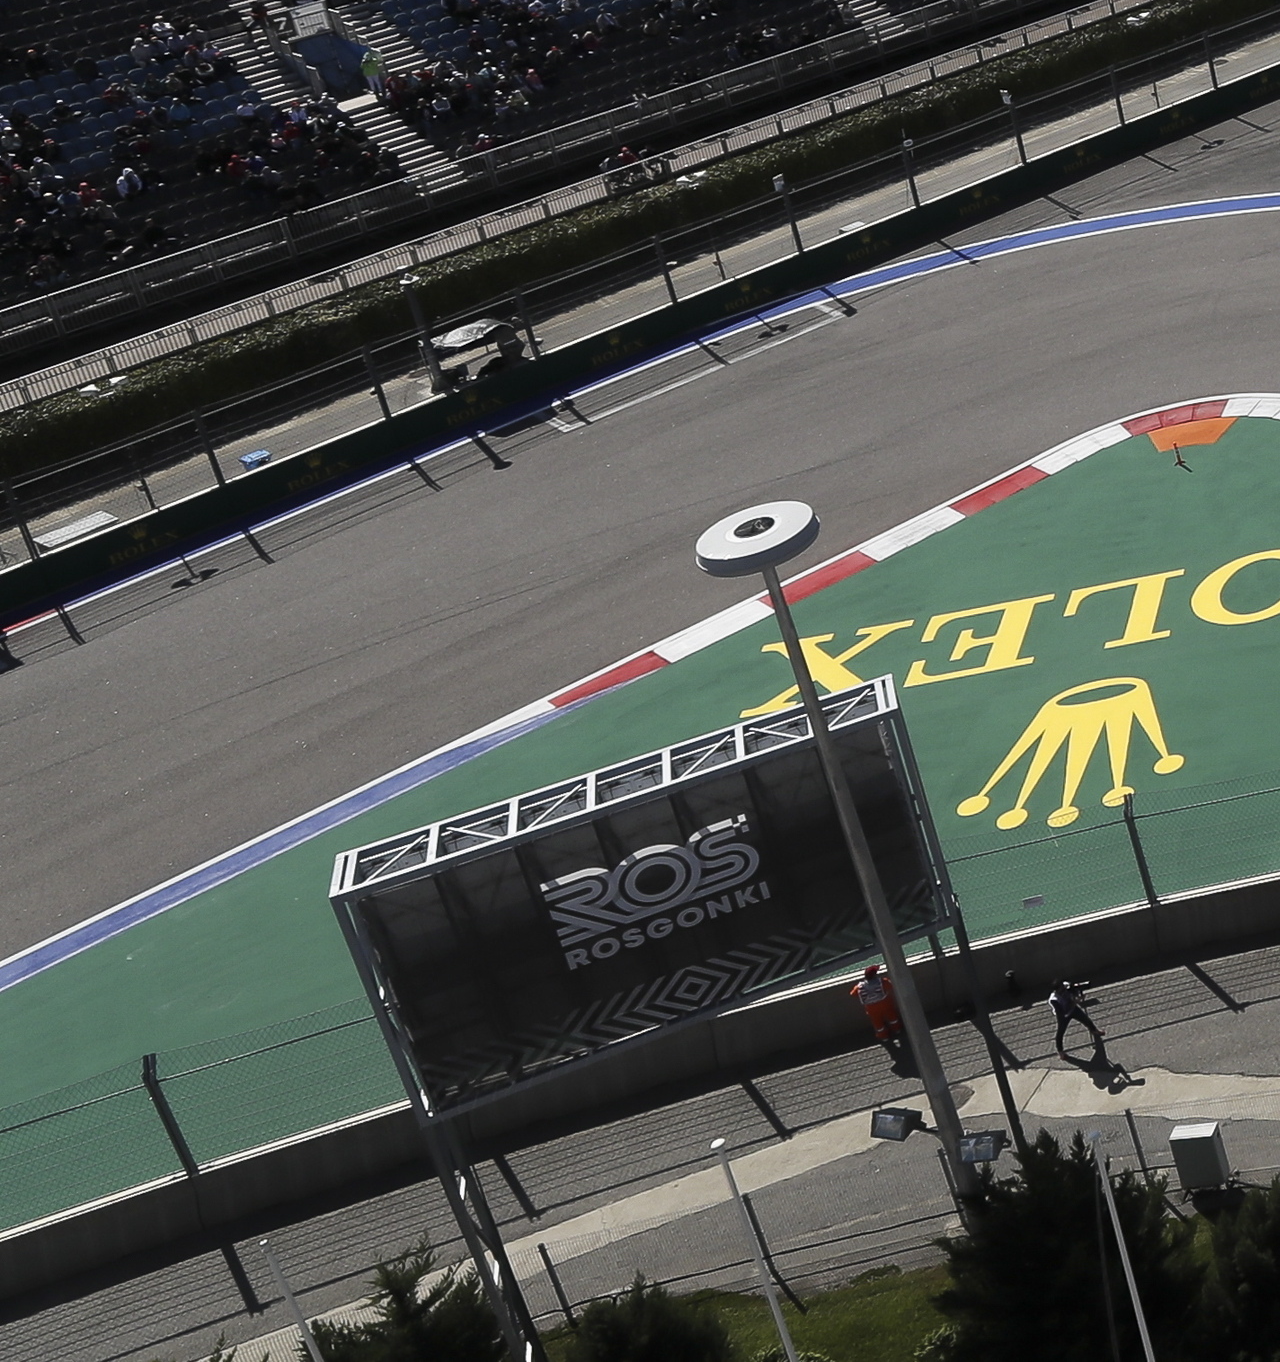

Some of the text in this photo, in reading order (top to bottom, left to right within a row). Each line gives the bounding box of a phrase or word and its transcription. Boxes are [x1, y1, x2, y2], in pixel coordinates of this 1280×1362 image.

[959, 195, 1001, 217] ROLEX
[846, 238, 892, 262] ROLEX
[724, 288, 773, 312] ROLEX
[592, 339, 645, 366] ROLEX
[446, 398, 504, 427] ROLEX
[288, 460, 350, 491] ROLEX
[109, 528, 179, 565] ROLEX
[540, 814, 761, 950] ROS
[565, 880, 772, 972] ROSGONKI
